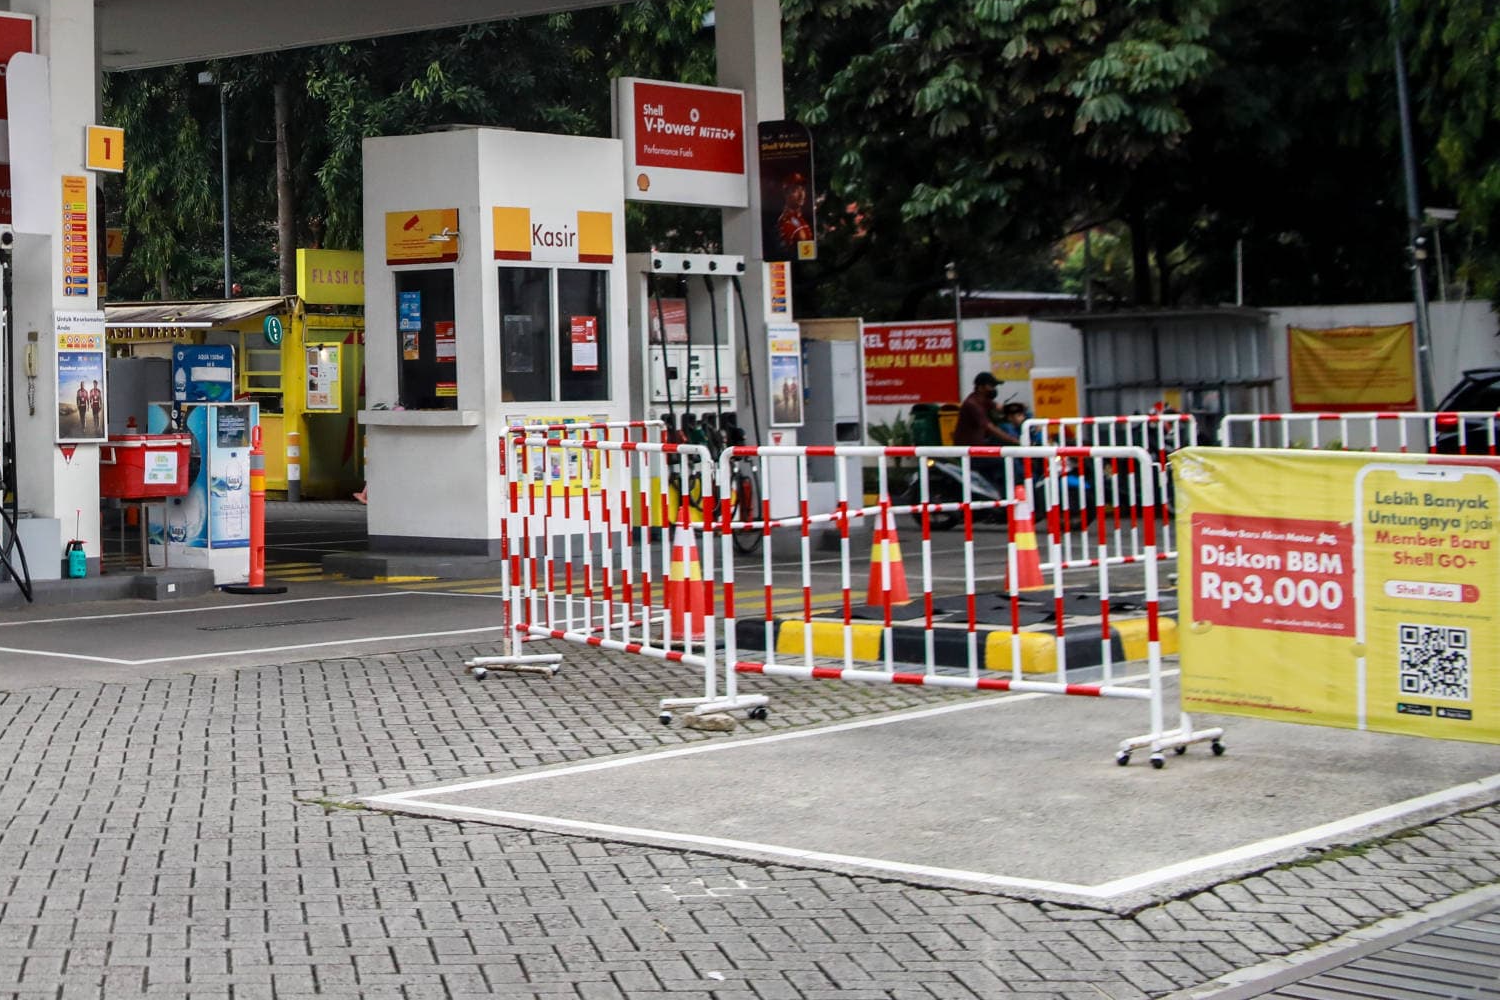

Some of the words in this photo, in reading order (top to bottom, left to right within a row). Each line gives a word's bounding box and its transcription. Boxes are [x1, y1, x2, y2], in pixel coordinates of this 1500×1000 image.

[643, 103, 664, 116] Shell
[644, 117, 696, 137] V-Power
[103, 137, 111, 160] 1
[644, 144, 679, 157] Performance
[679, 147, 693, 158] Fuels
[532, 223, 576, 247] Kasir
[312, 269, 349, 284] FLASH
[909, 352, 954, 367] MALAM
[1375, 491, 1419, 507] Lebih
[1423, 493, 1489, 512] Banyak
[1368, 510, 1461, 532] Untungnya
[1462, 514, 1493, 533] jadi
[1375, 530, 1445, 548] Member
[1451, 534, 1491, 550] Baru
[1200, 544, 1281, 570] Diskon
[1286, 550, 1343, 575] BBM
[1393, 551, 1434, 567] Shell
[1438, 554, 1477, 569] GO+
[1200, 571, 1343, 610] Rp3.000
[1395, 583, 1425, 596] Shell
[1428, 586, 1453, 598] Asia
